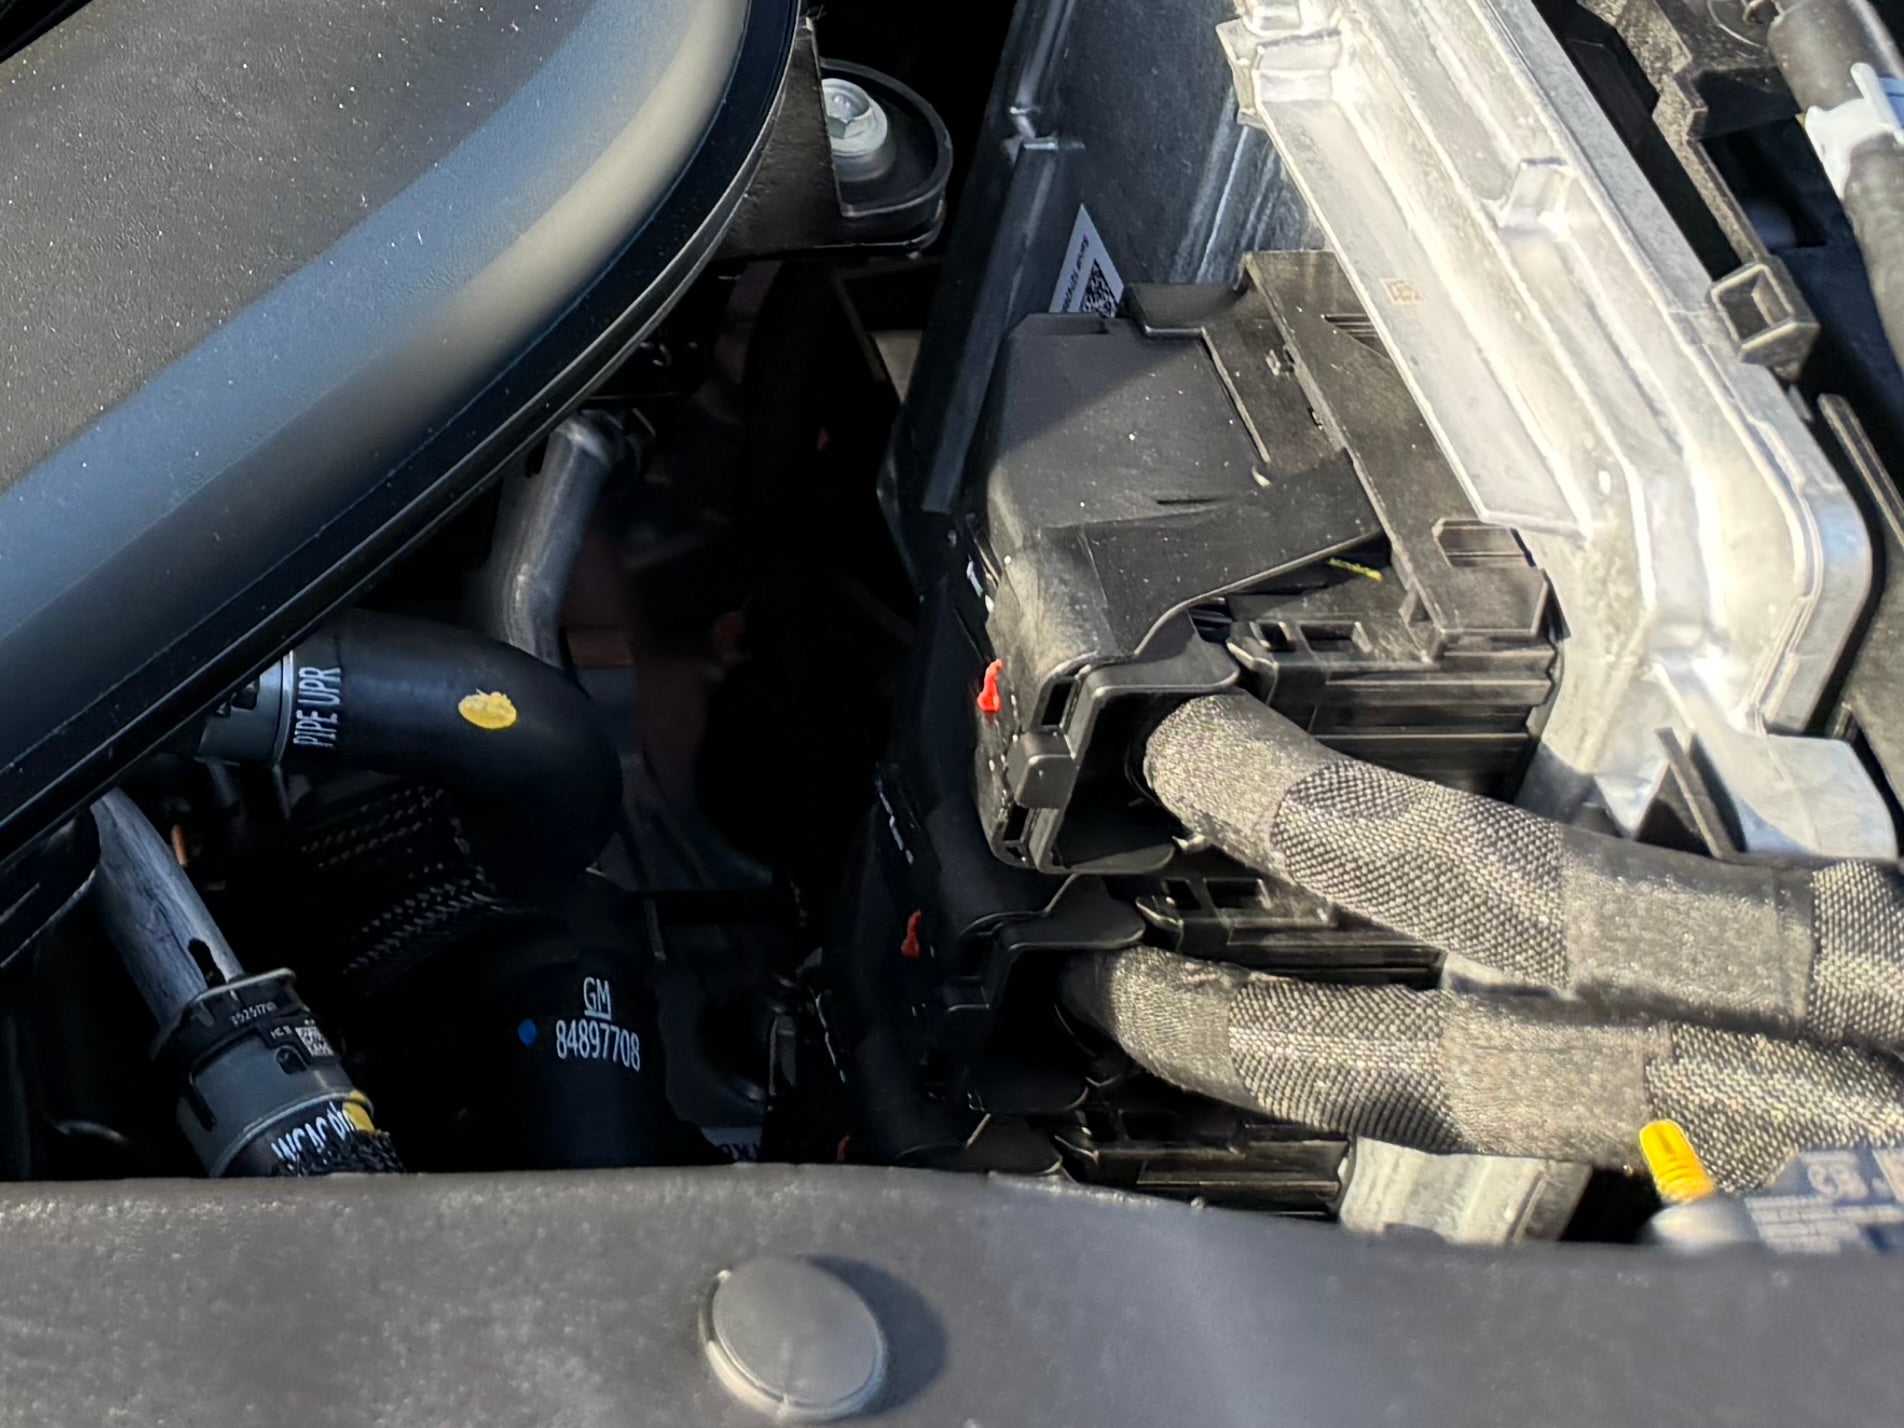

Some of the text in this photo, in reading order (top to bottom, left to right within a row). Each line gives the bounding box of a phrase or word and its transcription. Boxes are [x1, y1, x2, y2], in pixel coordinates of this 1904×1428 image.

[292, 666, 342, 750] PIPE UPR
[583, 976, 612, 1014] GM
[556, 1018, 641, 1072] 84897708
